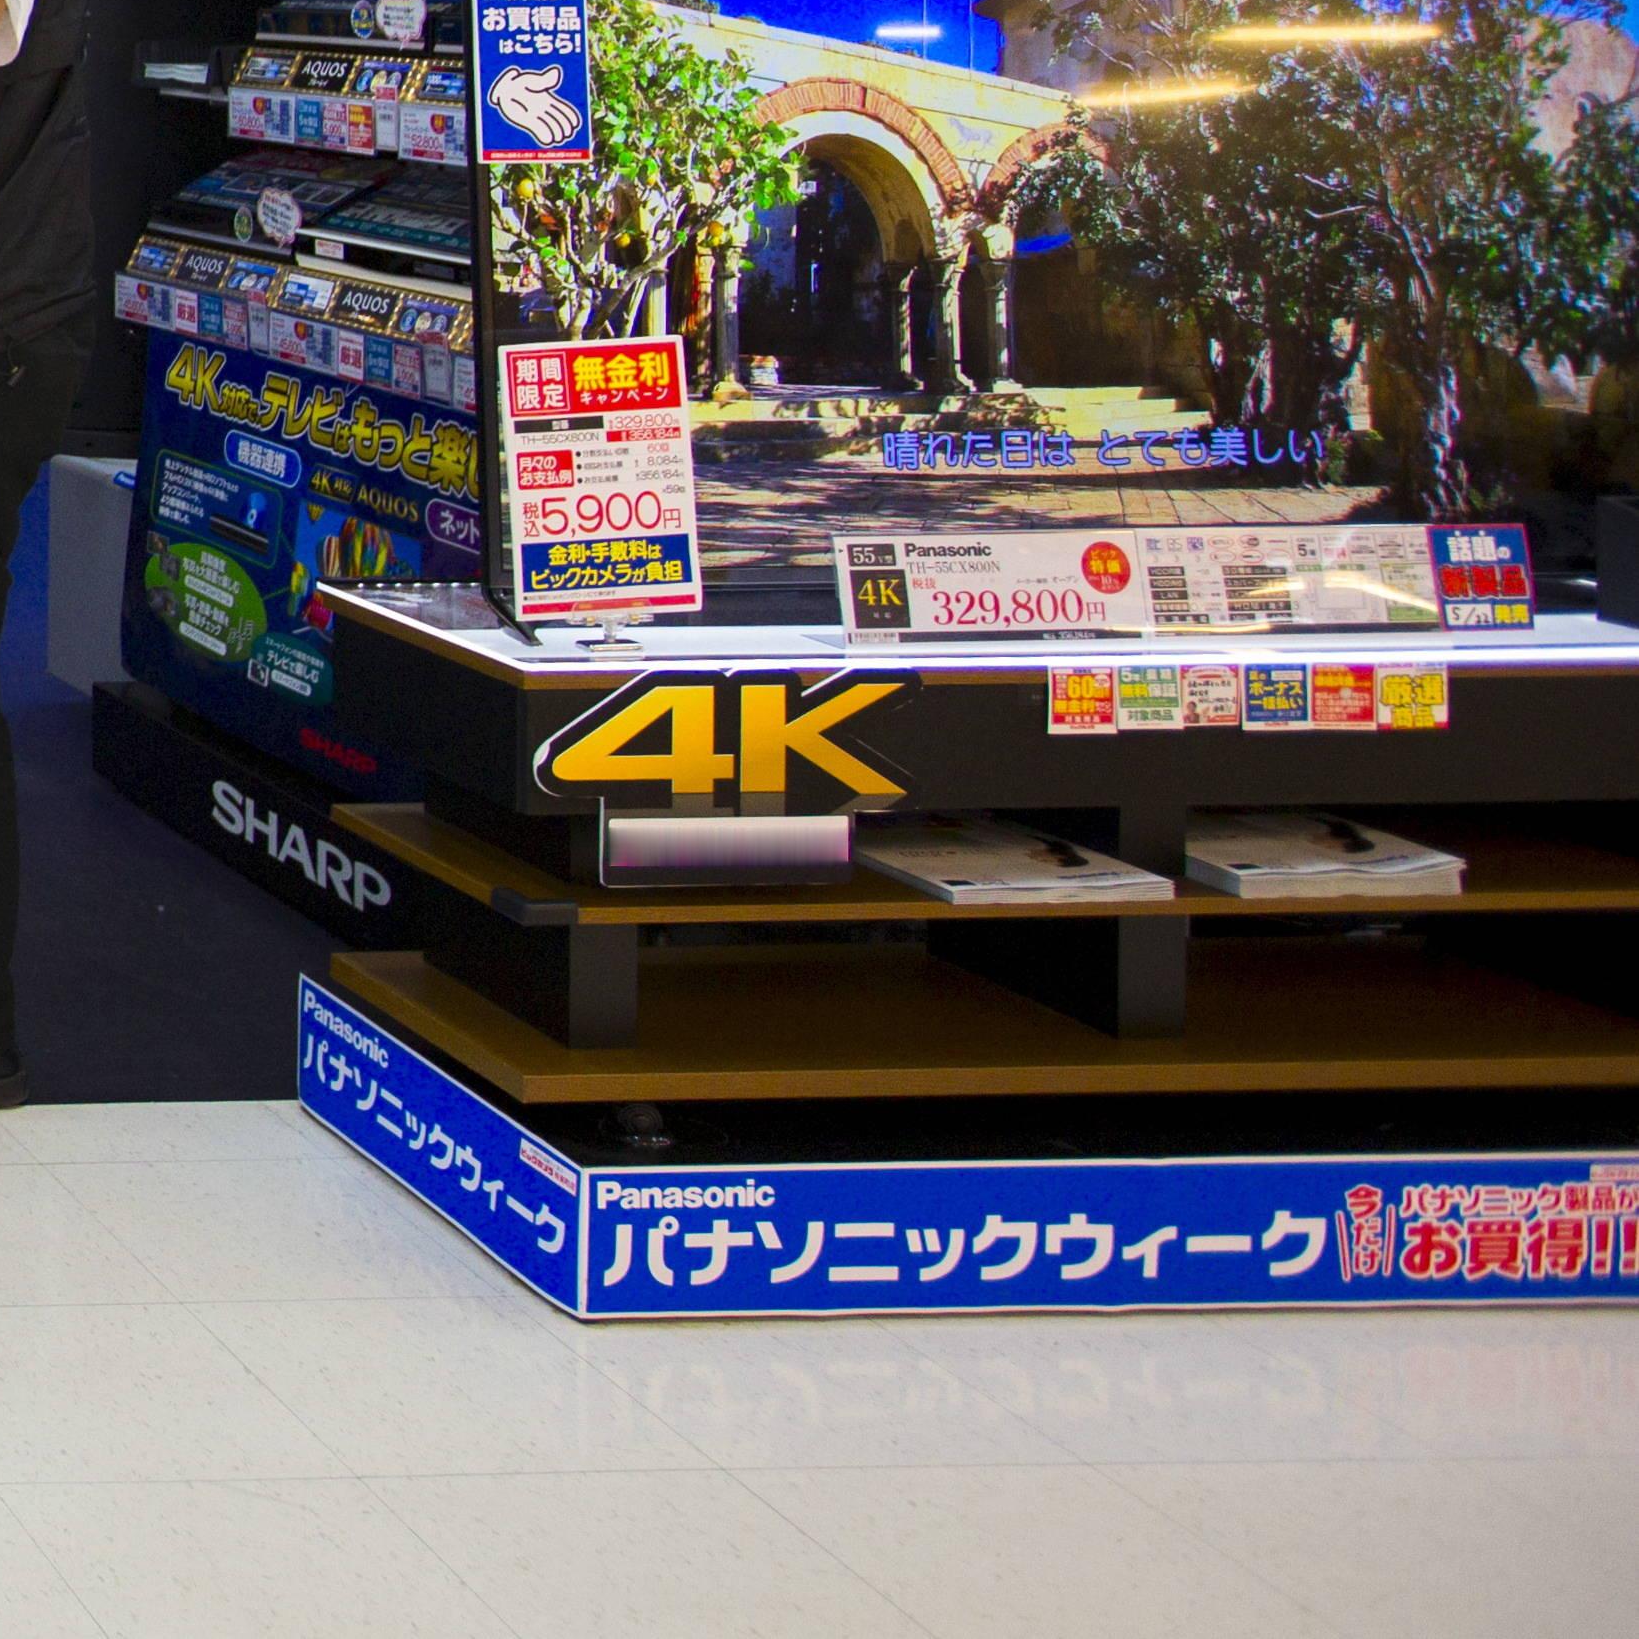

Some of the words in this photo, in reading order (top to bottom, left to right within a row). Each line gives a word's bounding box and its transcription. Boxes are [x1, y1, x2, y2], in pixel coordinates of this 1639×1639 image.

[482, 7, 581, 31] お買得品
[499, 33, 581, 54] はこちら!
[301, 60, 348, 78] AQUOS
[185, 253, 224, 274] AQUOS
[341, 290, 391, 314] AQUOS
[516, 357, 563, 384] 期間
[573, 351, 670, 392] 無金利
[516, 384, 565, 409] 限定
[580, 387, 669, 405] キャンペーン
[519, 455, 557, 470] 月々の
[883, 429, 1074, 471] 晴れた日は
[1096, 428, 1324, 467] とても美しい
[311, 471, 331, 494] 4K
[357, 484, 419, 523] AQUOS
[523, 503, 540, 538] 税込
[541, 491, 681, 538] 5,900円
[548, 541, 661, 566] 金利・手数料は
[904, 540, 992, 559] Panasonic
[1447, 530, 1511, 562] 話題の
[531, 561, 683, 590] ビックカメラが負担
[1439, 566, 1528, 599] 新製品
[856, 577, 902, 607] 4K
[932, 587, 1105, 627] 329,800円
[1248, 681, 1301, 695] ボーナス
[1127, 709, 1175, 722] 対象商品
[551, 683, 909, 795] 4K
[211, 779, 391, 912] SHARP
[303, 989, 389, 1069] Panasonic
[303, 1033, 567, 1255] パナソニックウィーク
[597, 1178, 777, 1211] Panasonic
[1343, 1183, 1383, 1278] 今だけ
[603, 1209, 1329, 1287] パナソニックウィーク
[1401, 1219, 1639, 1283] お買得!!
